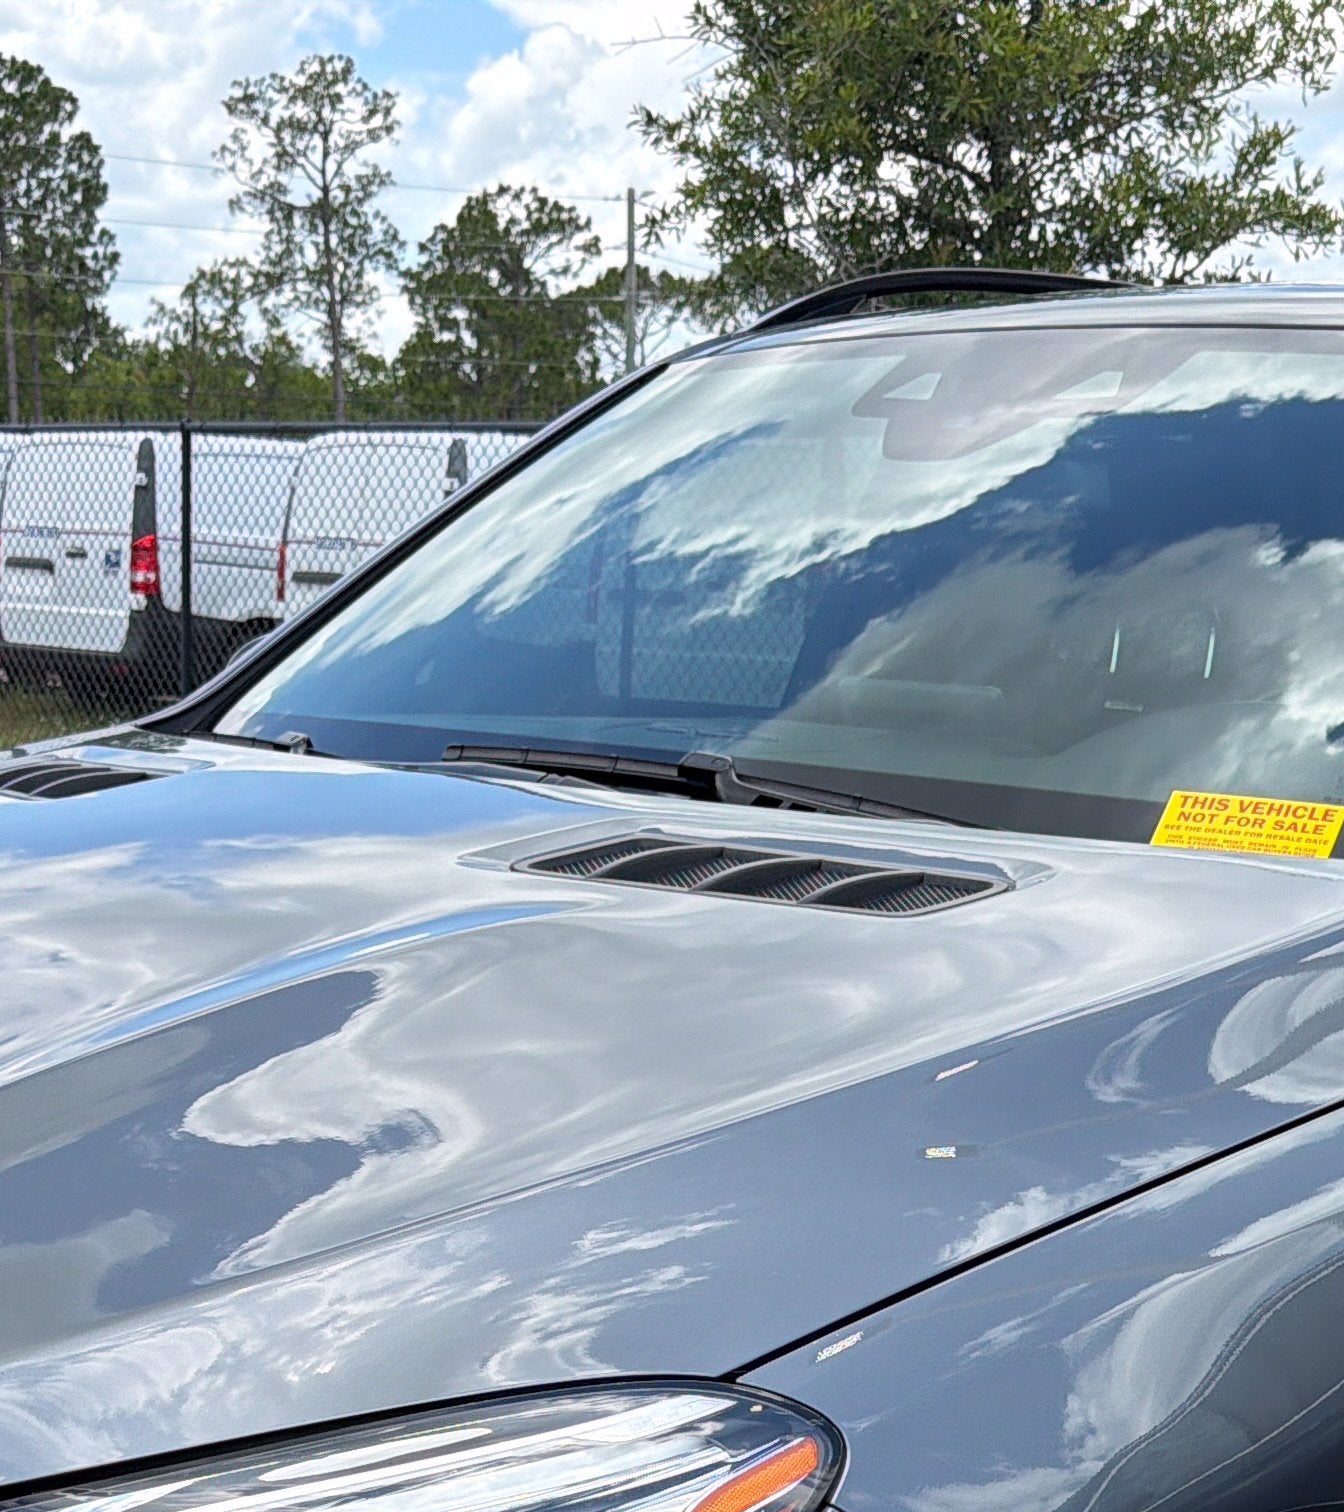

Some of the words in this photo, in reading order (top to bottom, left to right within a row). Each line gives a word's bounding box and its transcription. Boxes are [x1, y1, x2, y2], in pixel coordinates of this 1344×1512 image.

[1180, 795, 1230, 811] THIS
[1238, 800, 1338, 822] VEHICLE
[1177, 811, 1219, 825] NOT
[1224, 815, 1266, 829] FOR
[1272, 820, 1327, 835] SALE
[1184, 825, 1203, 833] THE
[1204, 827, 1242, 837] DEALER
[1244, 830, 1263, 839] FOR
[1266, 833, 1303, 843] RESALE
[1304, 837, 1329, 846] DATE
